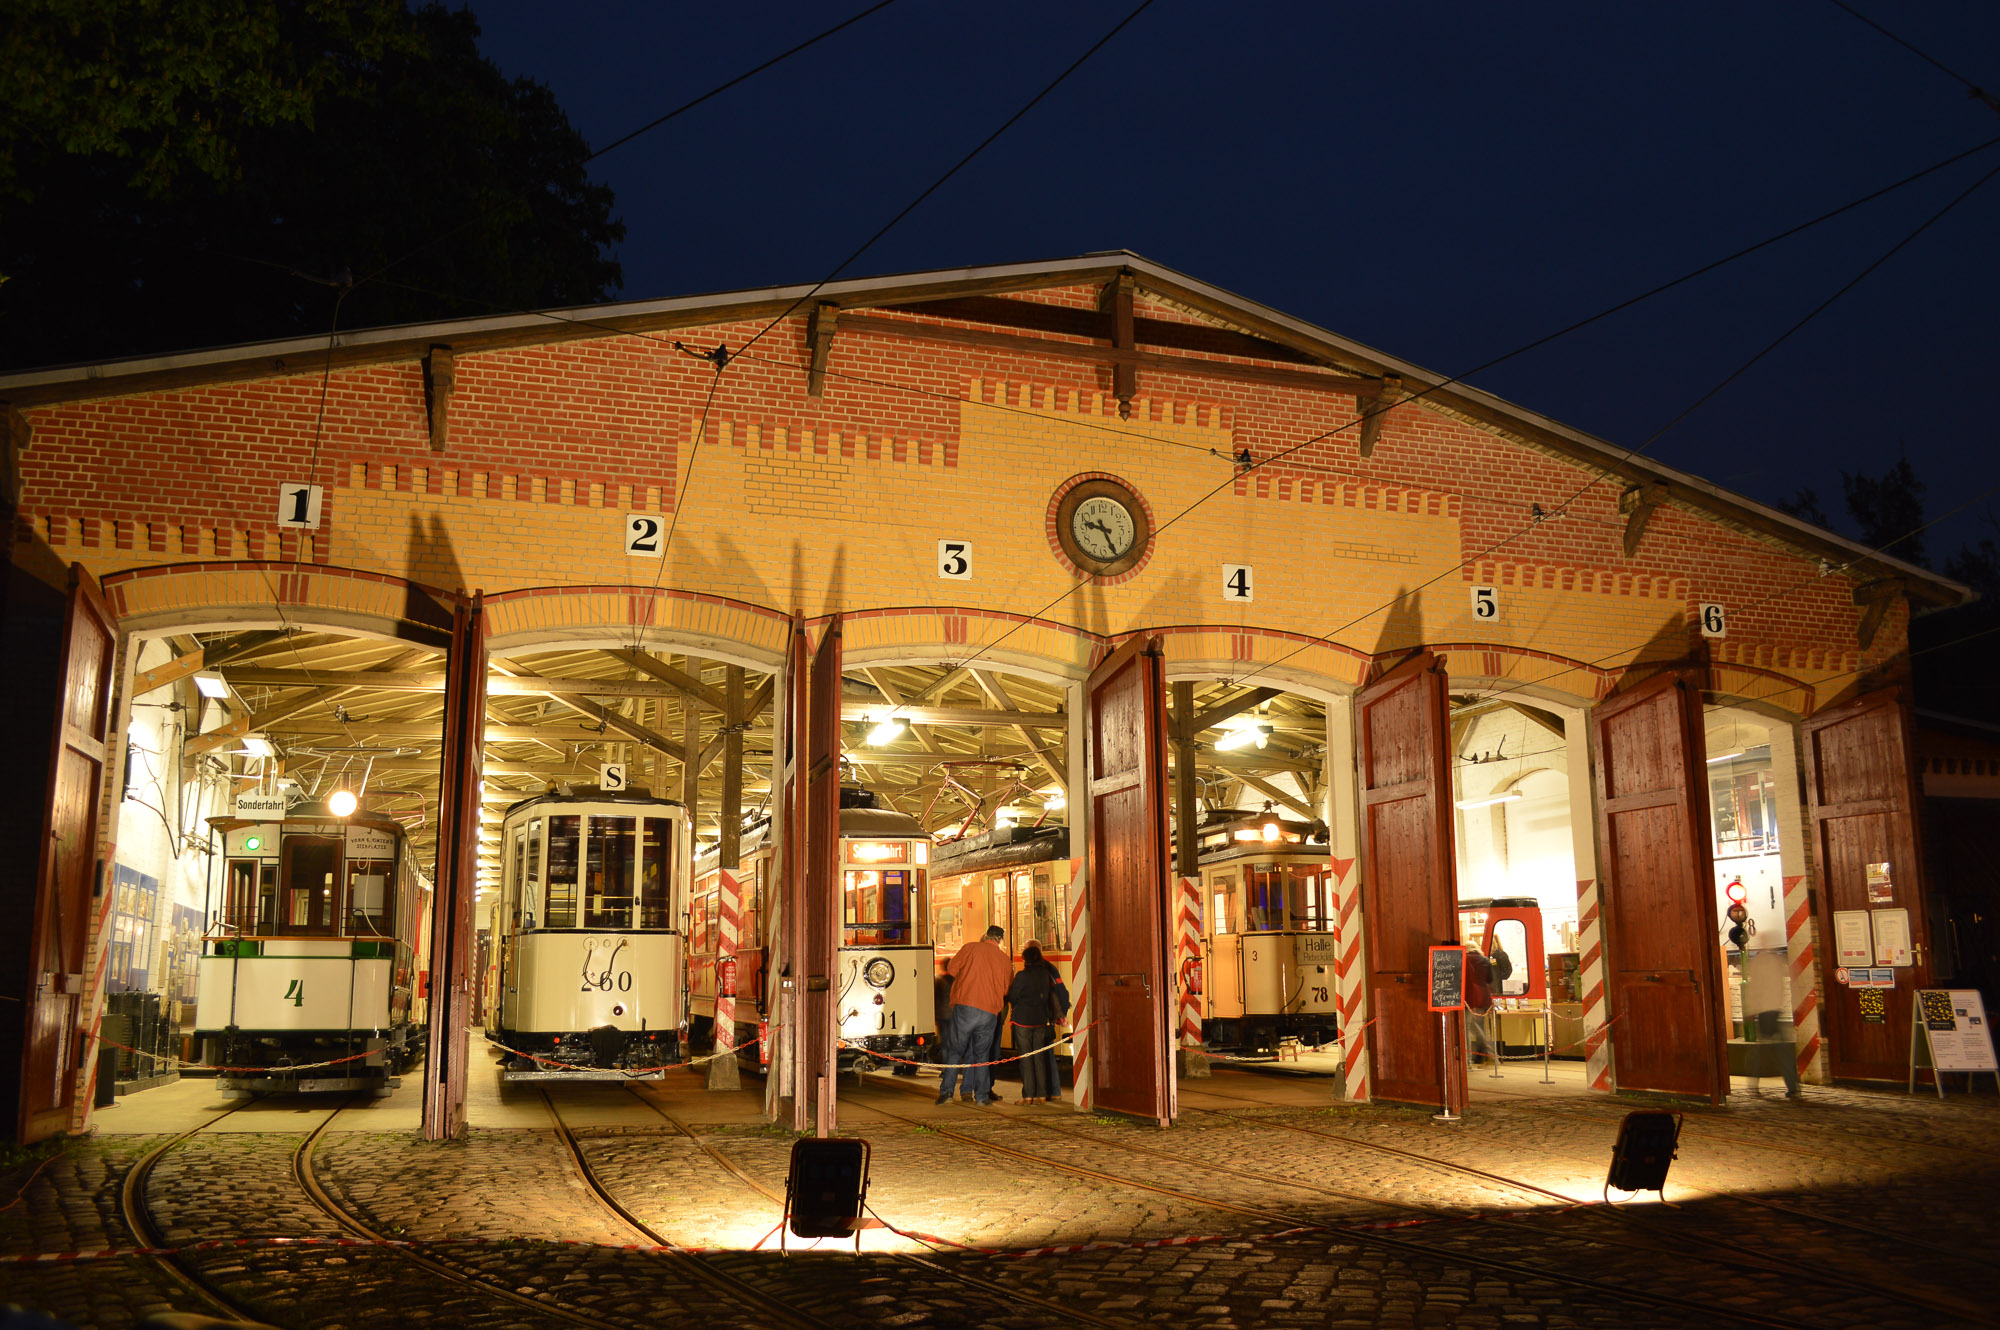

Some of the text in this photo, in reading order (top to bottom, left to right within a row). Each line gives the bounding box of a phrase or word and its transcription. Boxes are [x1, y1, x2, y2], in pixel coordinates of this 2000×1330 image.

[287, 489, 311, 523] 1
[1098, 503, 1107, 513] 12
[1081, 512, 1091, 522] 10
[1115, 513, 1122, 523] 2
[630, 519, 658, 552] 2
[1118, 525, 1125, 536] 3
[1083, 534, 1091, 545] 8
[1090, 543, 1098, 553] 7
[1099, 545, 1107, 557] 6
[943, 544, 968, 575] 3
[1227, 568, 1251, 598] 4
[1476, 588, 1496, 617] 5
[1704, 606, 1723, 633] 6
[606, 766, 622, 788] S
[237, 799, 284, 810] Sonderfahrt
[1305, 937, 1331, 951] Halle
[1252, 950, 1258, 962] 3
[581, 971, 632, 992] 260
[284, 979, 304, 1007] 4
[1311, 986, 1328, 1003] 78
